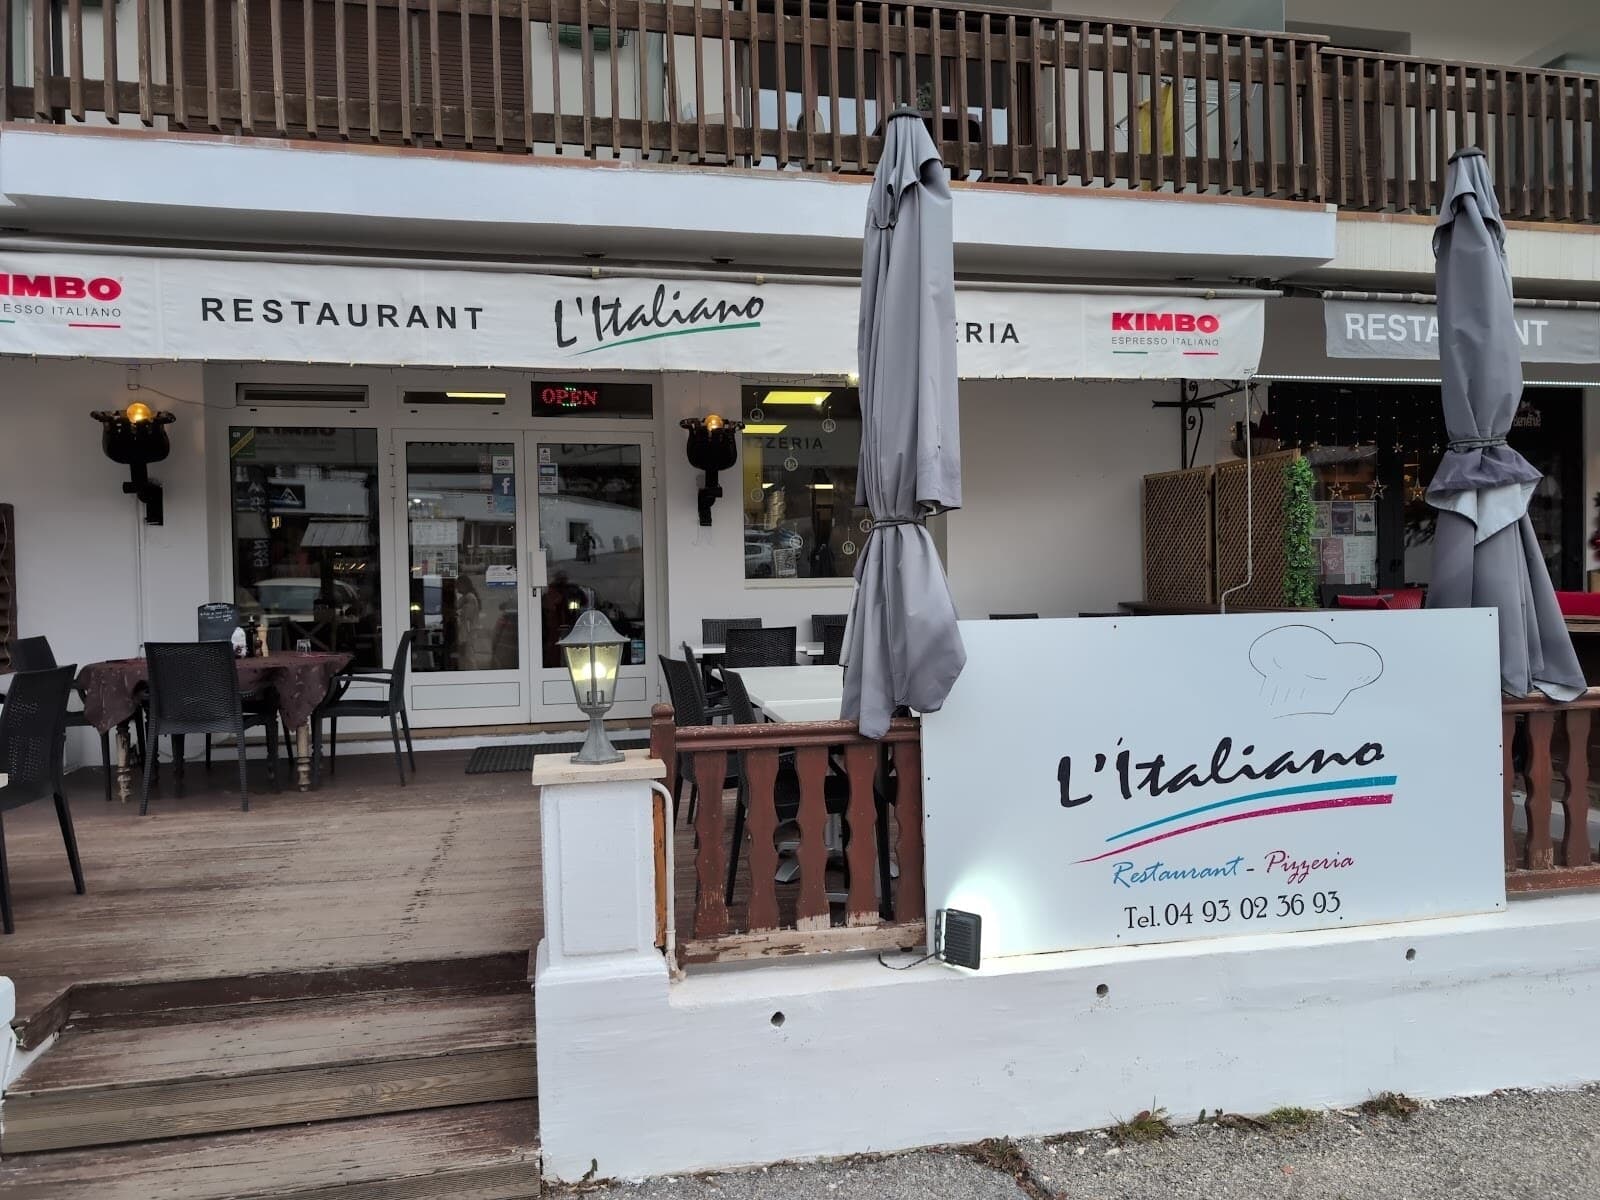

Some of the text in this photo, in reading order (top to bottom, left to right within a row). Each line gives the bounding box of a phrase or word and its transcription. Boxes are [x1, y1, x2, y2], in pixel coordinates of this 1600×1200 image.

[0, 273, 122, 301] IMBO
[2, 303, 121, 318] ESSO ITALIANO
[201, 297, 483, 330] RESTAURANT
[554, 284, 765, 348] L'Italiano
[1111, 312, 1219, 334] KIMBO
[956, 322, 1020, 344] RIA
[1111, 336, 1219, 347] ESPRESSO ITALIANO
[1345, 313, 1549, 346] RESTANT
[542, 387, 598, 405] OPEN
[1112, 854, 1245, 888] Restaurant
[1264, 850, 1354, 885] Pizzeria
[1203, 899, 1231, 923] 93
[1240, 896, 1268, 920] 02
[1276, 893, 1305, 918] 36
[1312, 890, 1341, 914] 93
